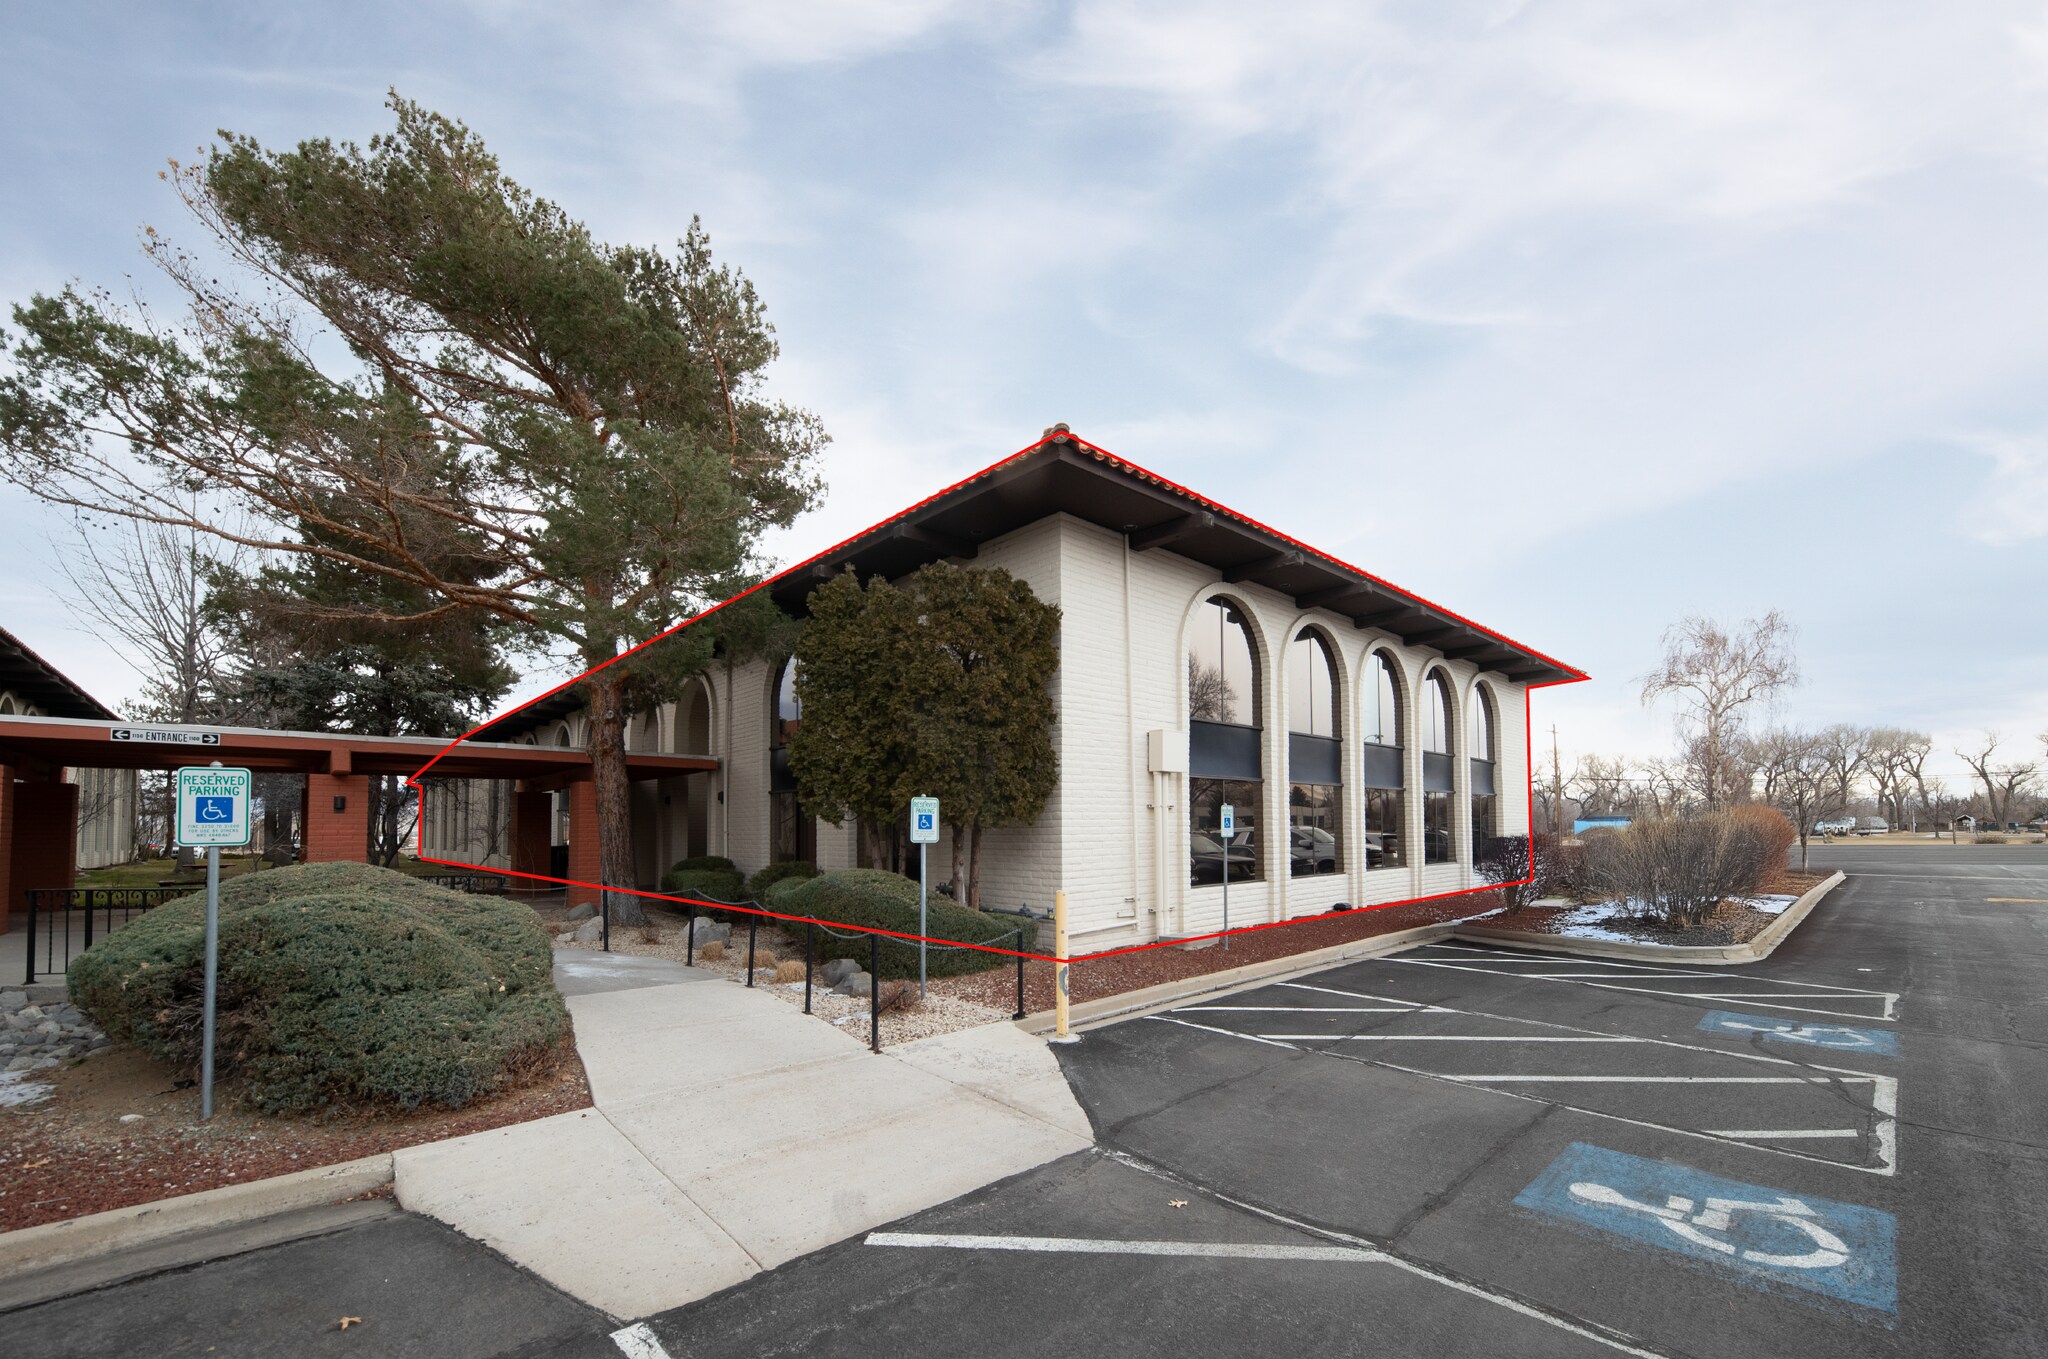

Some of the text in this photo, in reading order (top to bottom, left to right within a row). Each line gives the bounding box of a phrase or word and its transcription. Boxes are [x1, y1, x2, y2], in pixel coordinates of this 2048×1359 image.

[146, 731, 188, 743] ENTRANCE
[183, 775, 245, 786] RESERVED
[188, 786, 240, 796] PARKING
